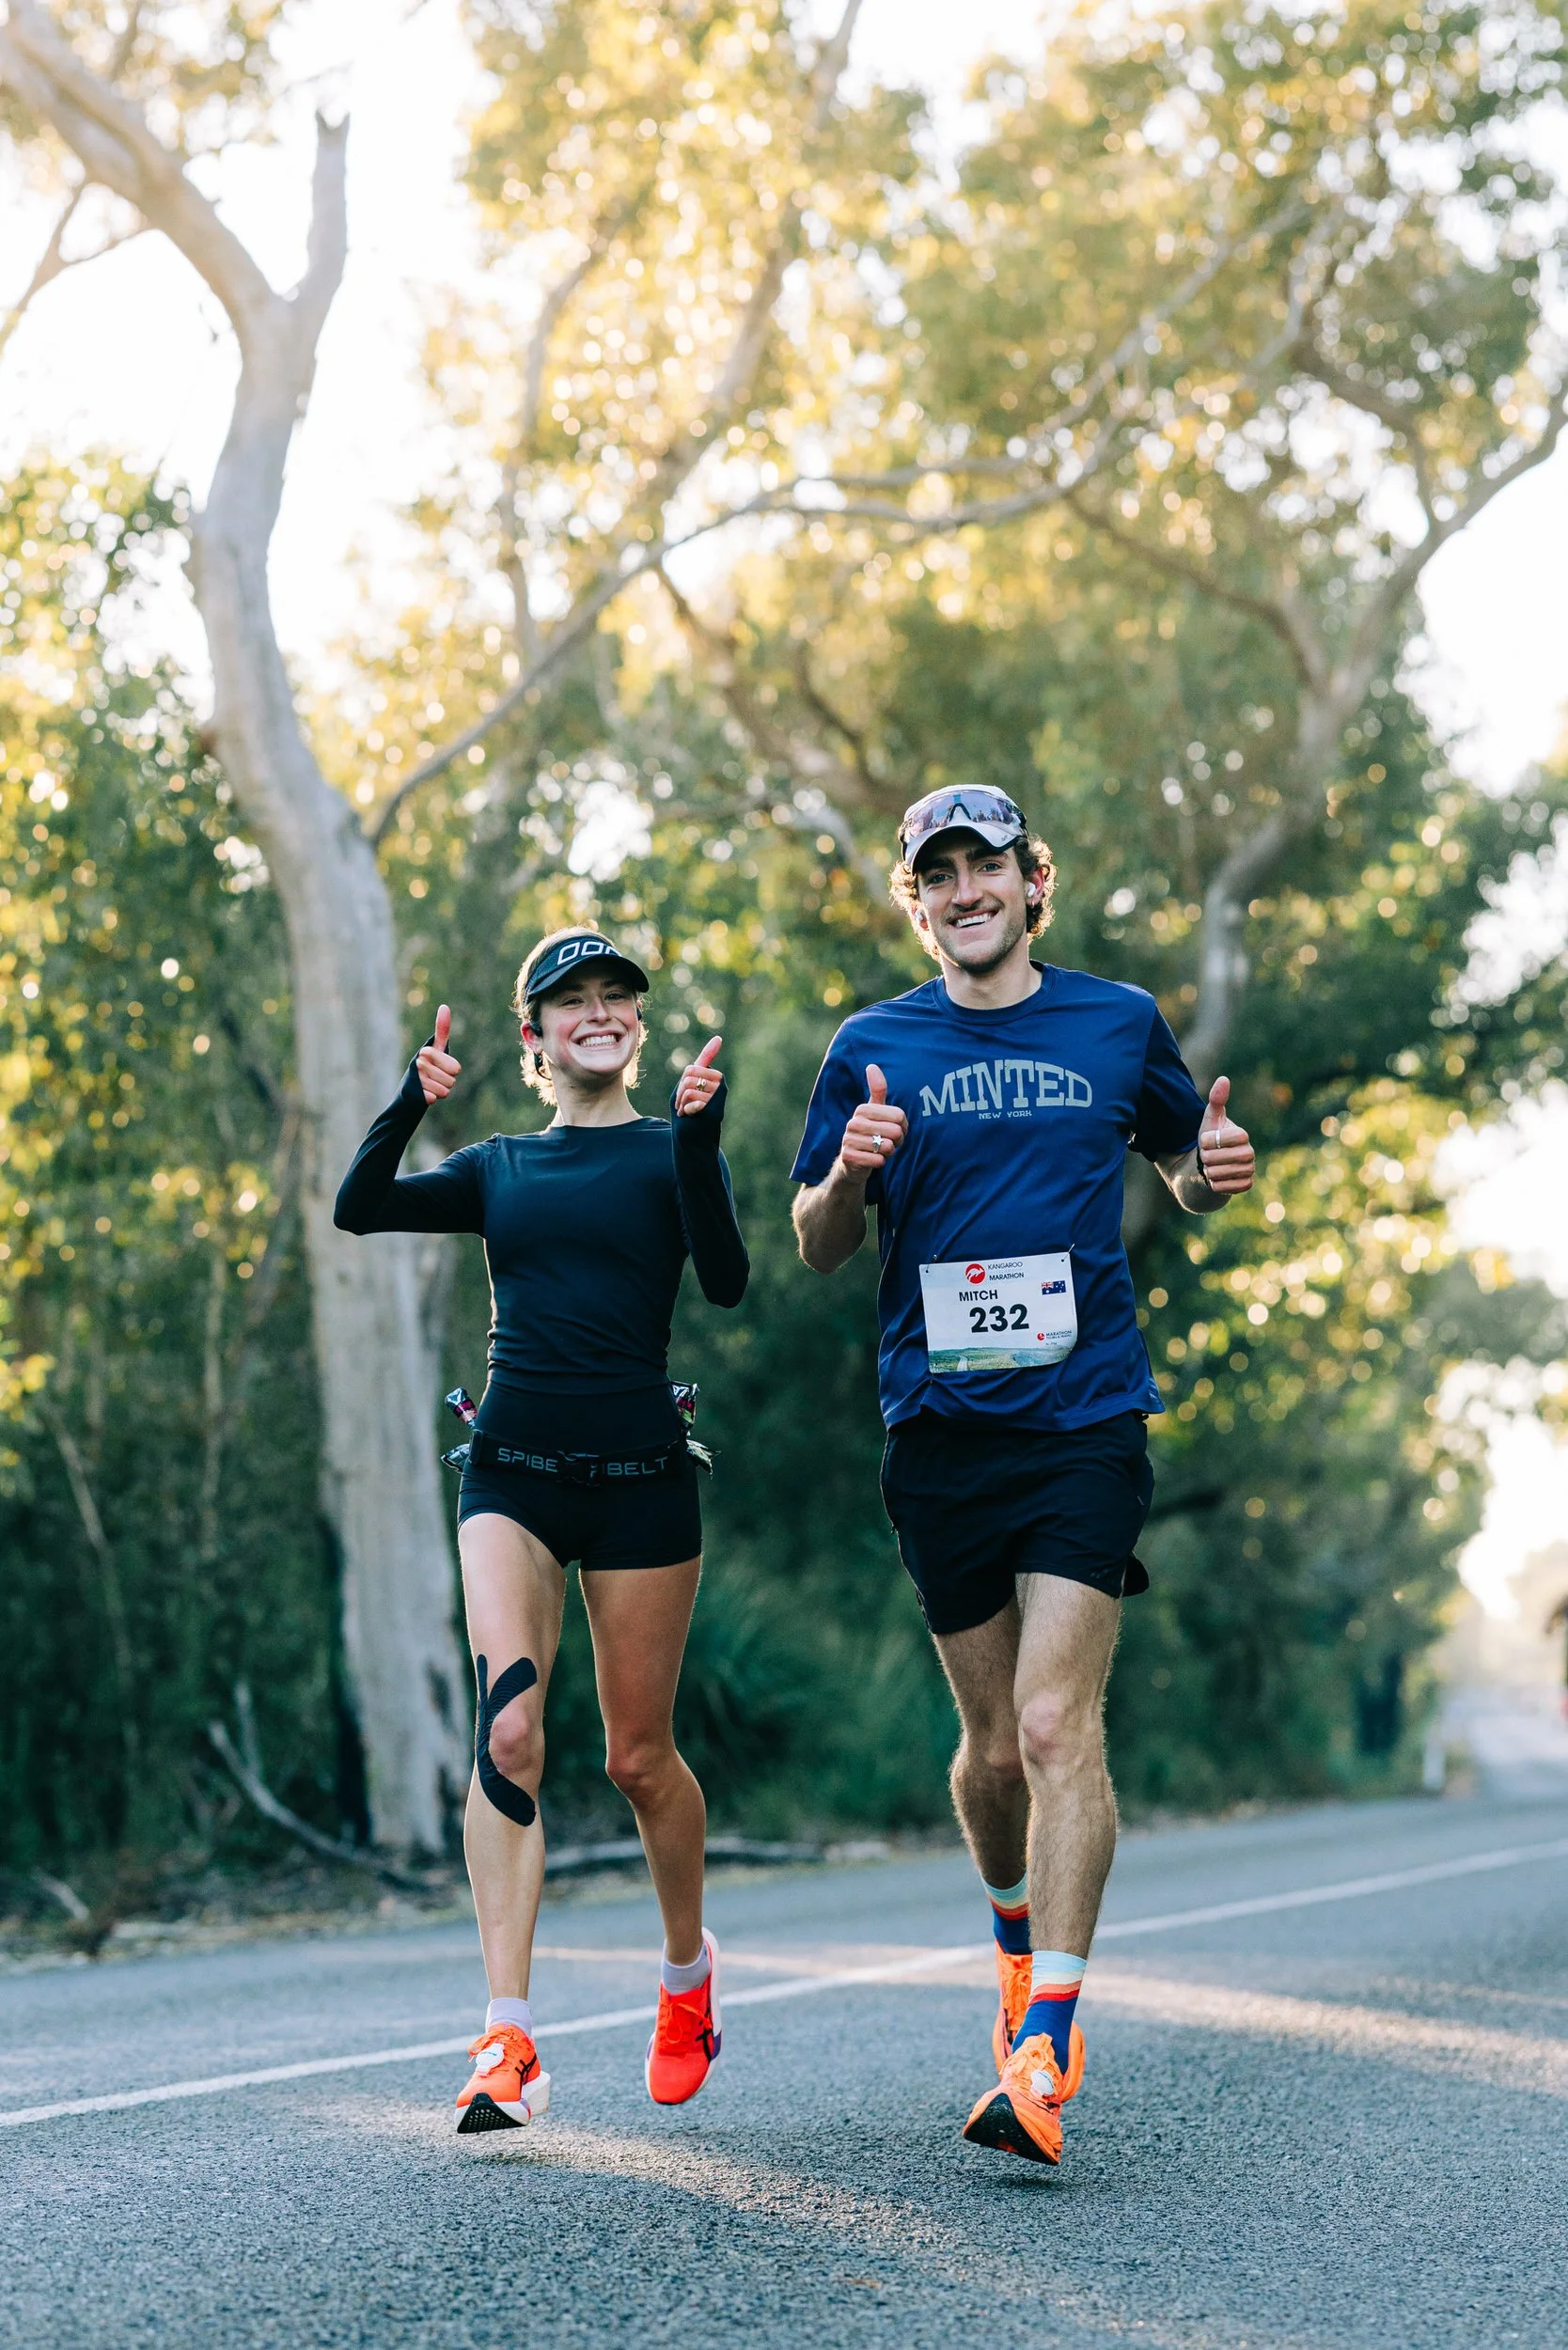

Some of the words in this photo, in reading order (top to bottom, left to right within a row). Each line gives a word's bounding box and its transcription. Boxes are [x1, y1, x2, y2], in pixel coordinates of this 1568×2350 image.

[919, 1059, 1092, 1117] MINTED
[979, 1111, 1001, 1120] NEW
[1007, 1109, 1032, 1118] YORK
[988, 1261, 1023, 1270] KANGAROO
[989, 1272, 1025, 1280] MARATHON
[959, 1290, 998, 1301] MITCH
[969, 1304, 1029, 1333] 232
